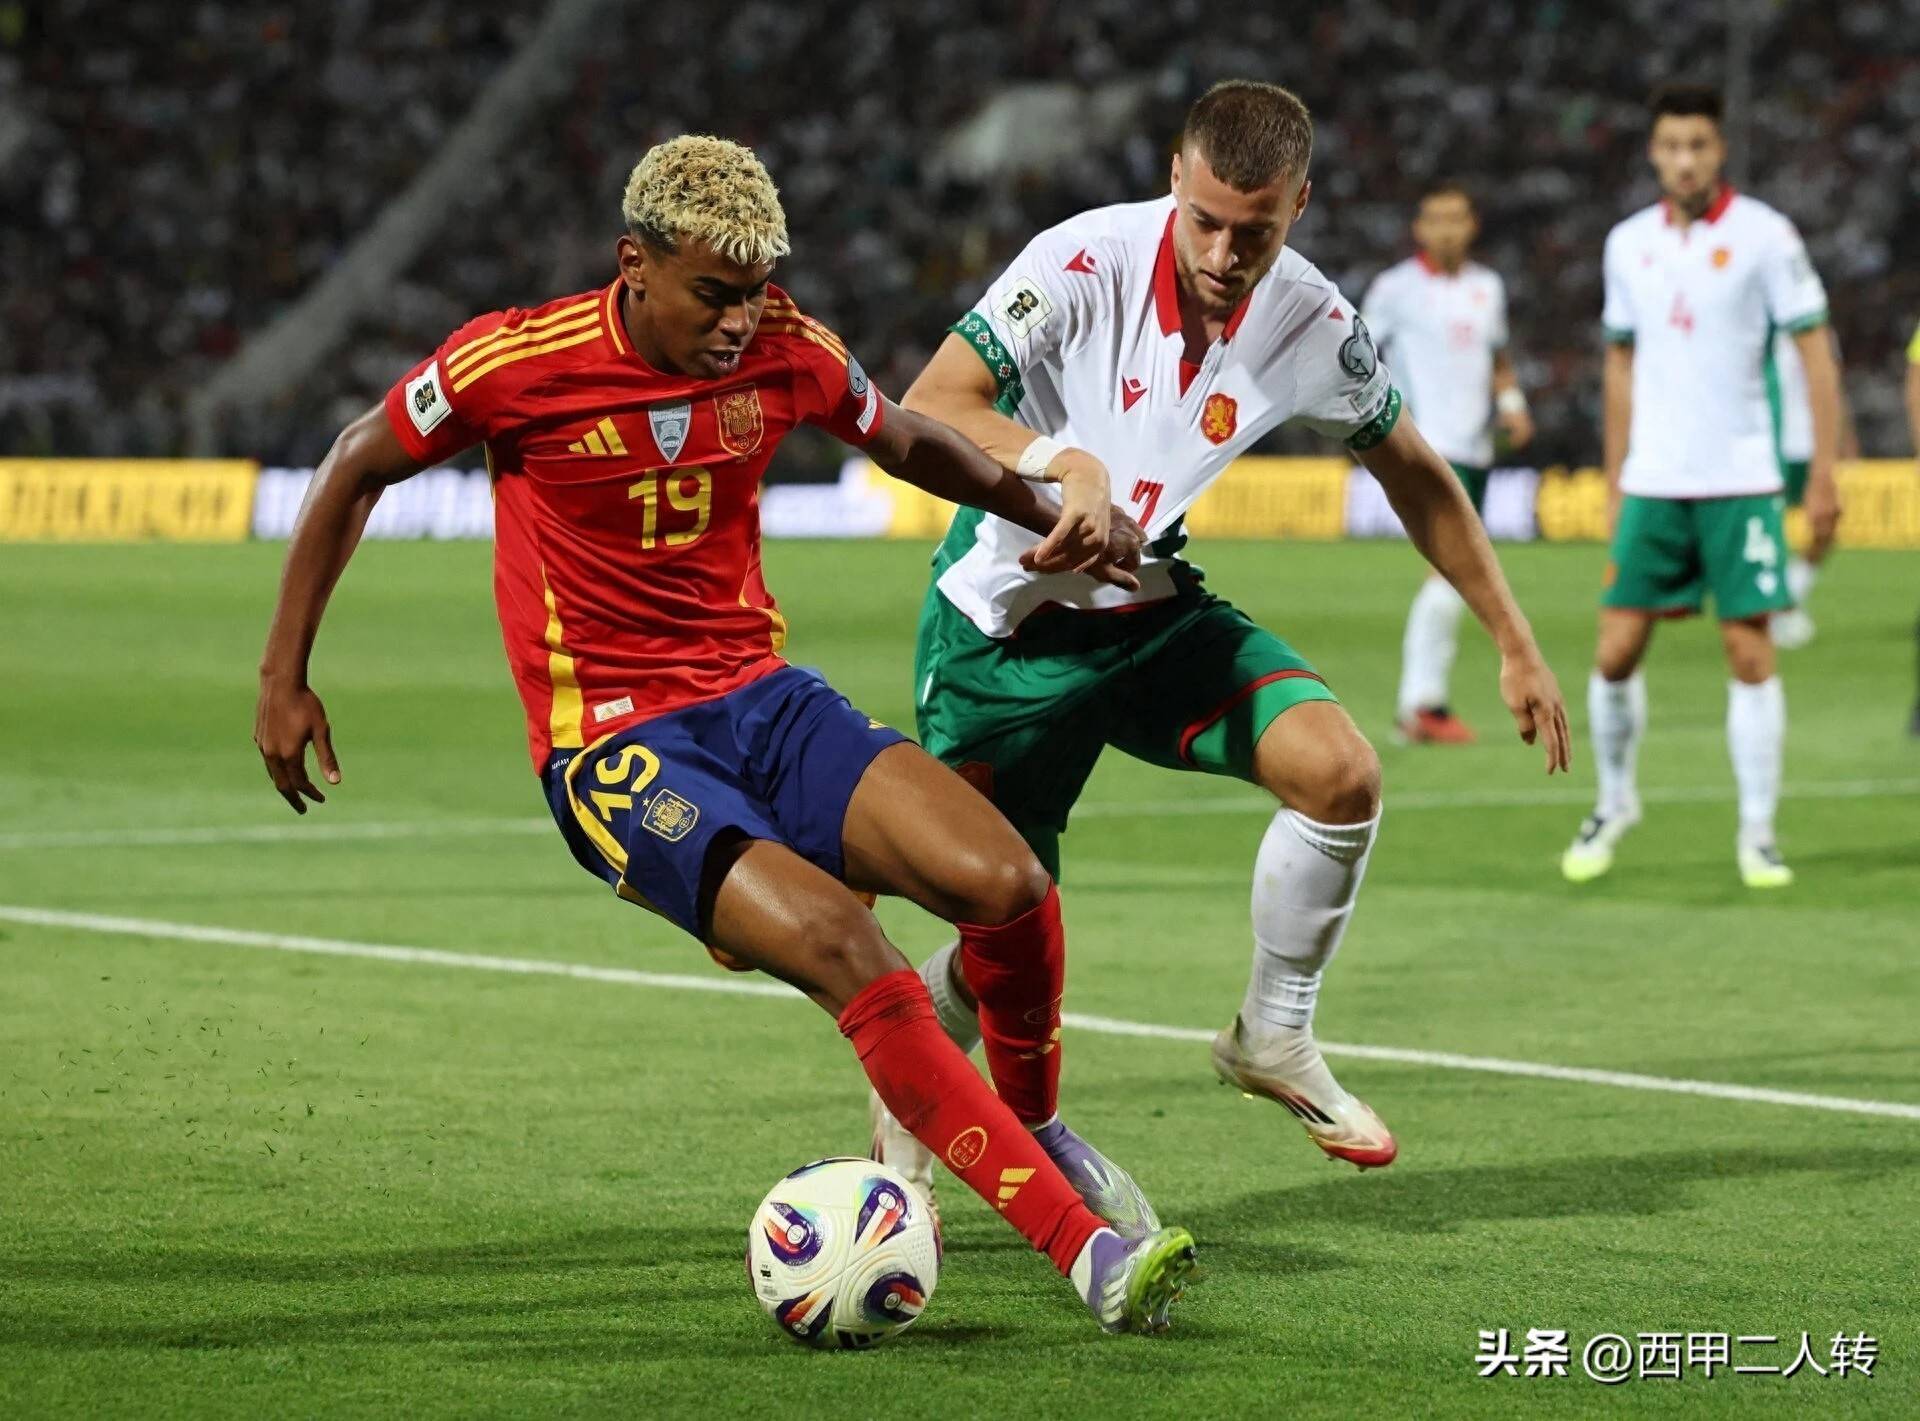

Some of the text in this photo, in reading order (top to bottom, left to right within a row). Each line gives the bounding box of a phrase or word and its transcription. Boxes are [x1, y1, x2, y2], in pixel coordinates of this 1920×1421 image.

[1669, 291, 1695, 340] 4
[628, 466, 712, 550] 19
[1129, 477, 1164, 530] 7
[1743, 515, 1777, 567] 4
[590, 744, 661, 822] 19
